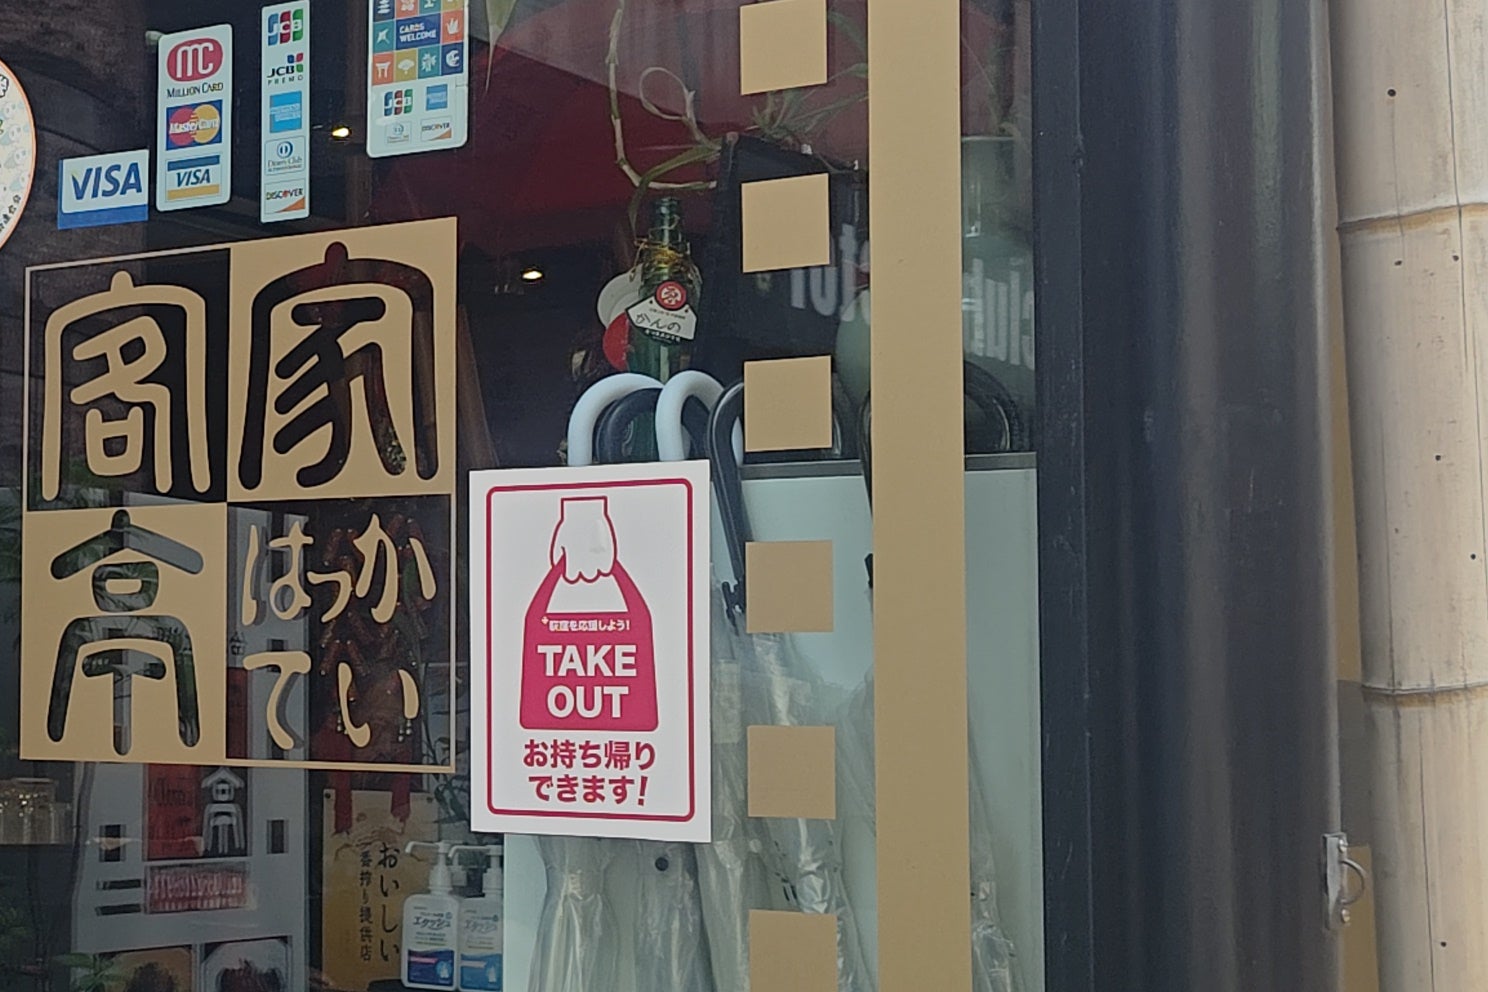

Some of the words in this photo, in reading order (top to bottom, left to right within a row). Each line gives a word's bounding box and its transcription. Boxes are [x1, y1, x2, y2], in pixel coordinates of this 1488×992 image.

[400, 22, 425, 34] CARDS
[400, 29, 437, 42] WELCOME
[267, 65, 295, 78] JCB
[71, 162, 143, 200] VISA
[176, 168, 211, 187] VISA
[266, 188, 303, 200] DISCOVER
[241, 512, 437, 626] はっか
[46, 509, 204, 756] 亭
[538, 644, 637, 677] TAKE
[242, 650, 420, 750] てい
[547, 685, 630, 719] OUT
[523, 739, 656, 771] お持ち帰り
[528, 775, 649, 806] できます!
[378, 841, 400, 963] おいしい
